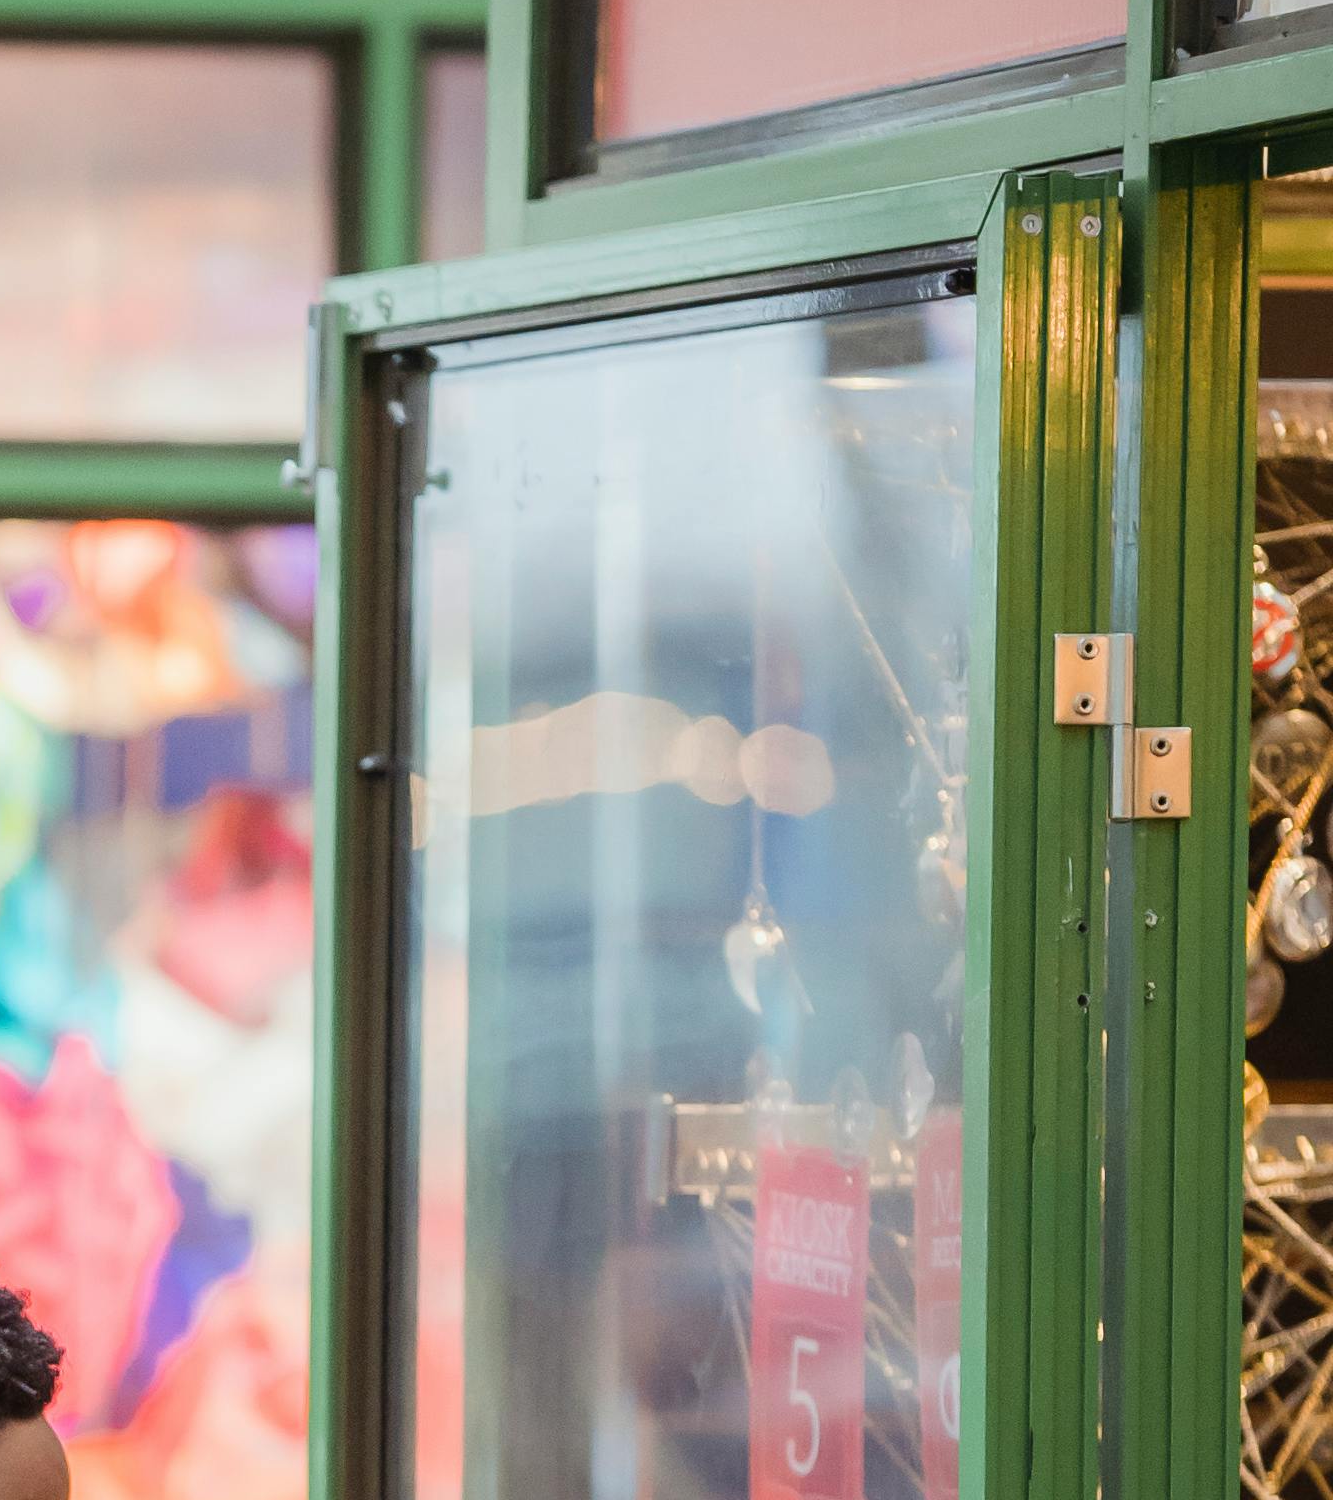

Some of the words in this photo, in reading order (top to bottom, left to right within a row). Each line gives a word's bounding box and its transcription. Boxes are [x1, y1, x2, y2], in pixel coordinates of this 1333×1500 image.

[767, 1191, 854, 1260] KIOSK
[765, 1245, 854, 1299] CAPACITY
[786, 1334, 820, 1477] 5
